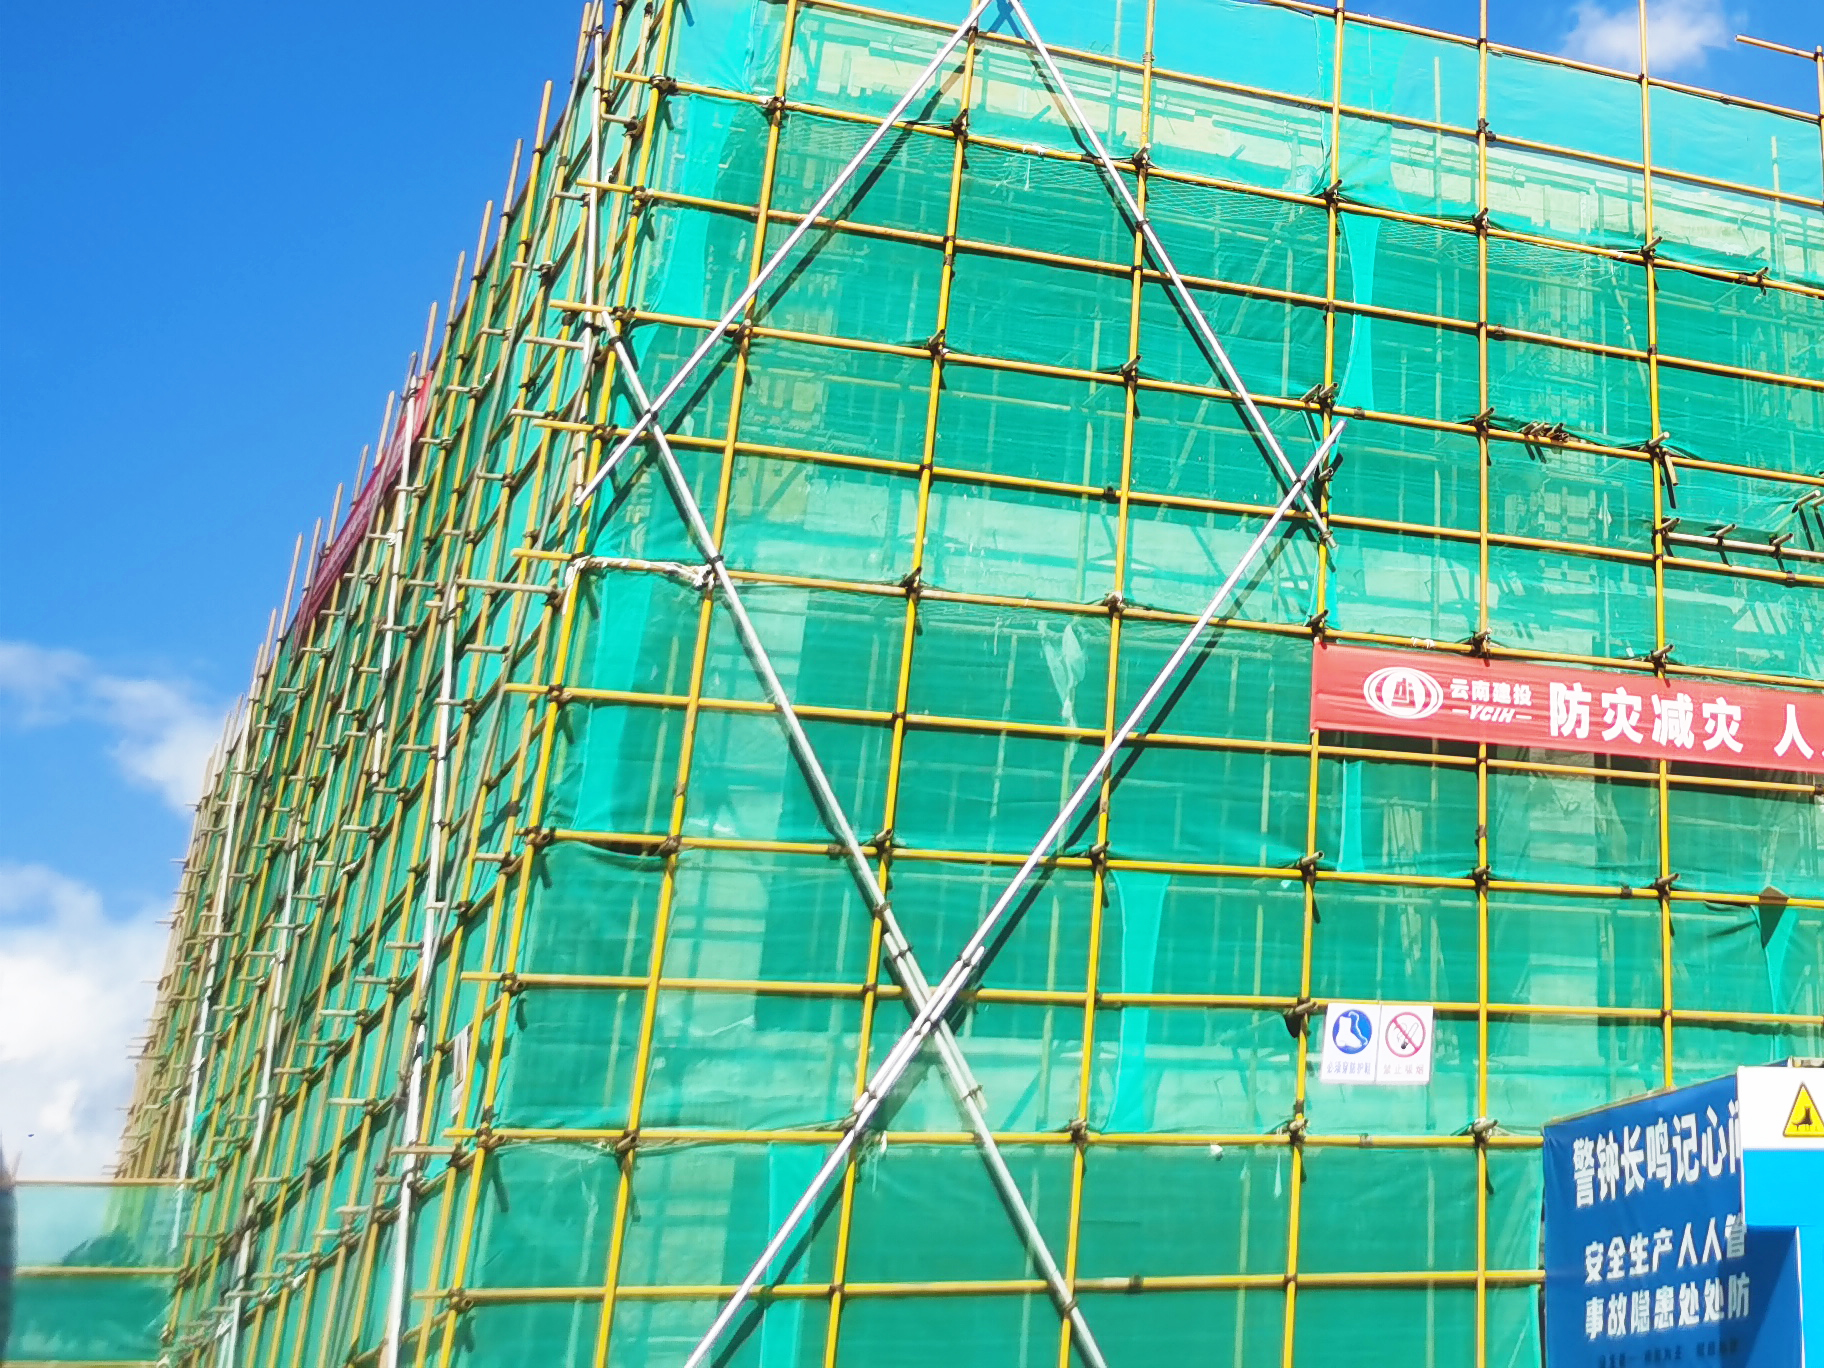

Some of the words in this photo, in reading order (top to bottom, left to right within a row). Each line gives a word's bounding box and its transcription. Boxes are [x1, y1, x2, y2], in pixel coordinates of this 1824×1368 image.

[1450, 678, 1532, 706] 云南建投
[1469, 704, 1516, 723] YCIH
[1548, 681, 1743, 753] 防灾减灾
[1584, 1212, 1747, 1284] 安全生产人人管
[1584, 1272, 1750, 1341] 事故隐患处处防
